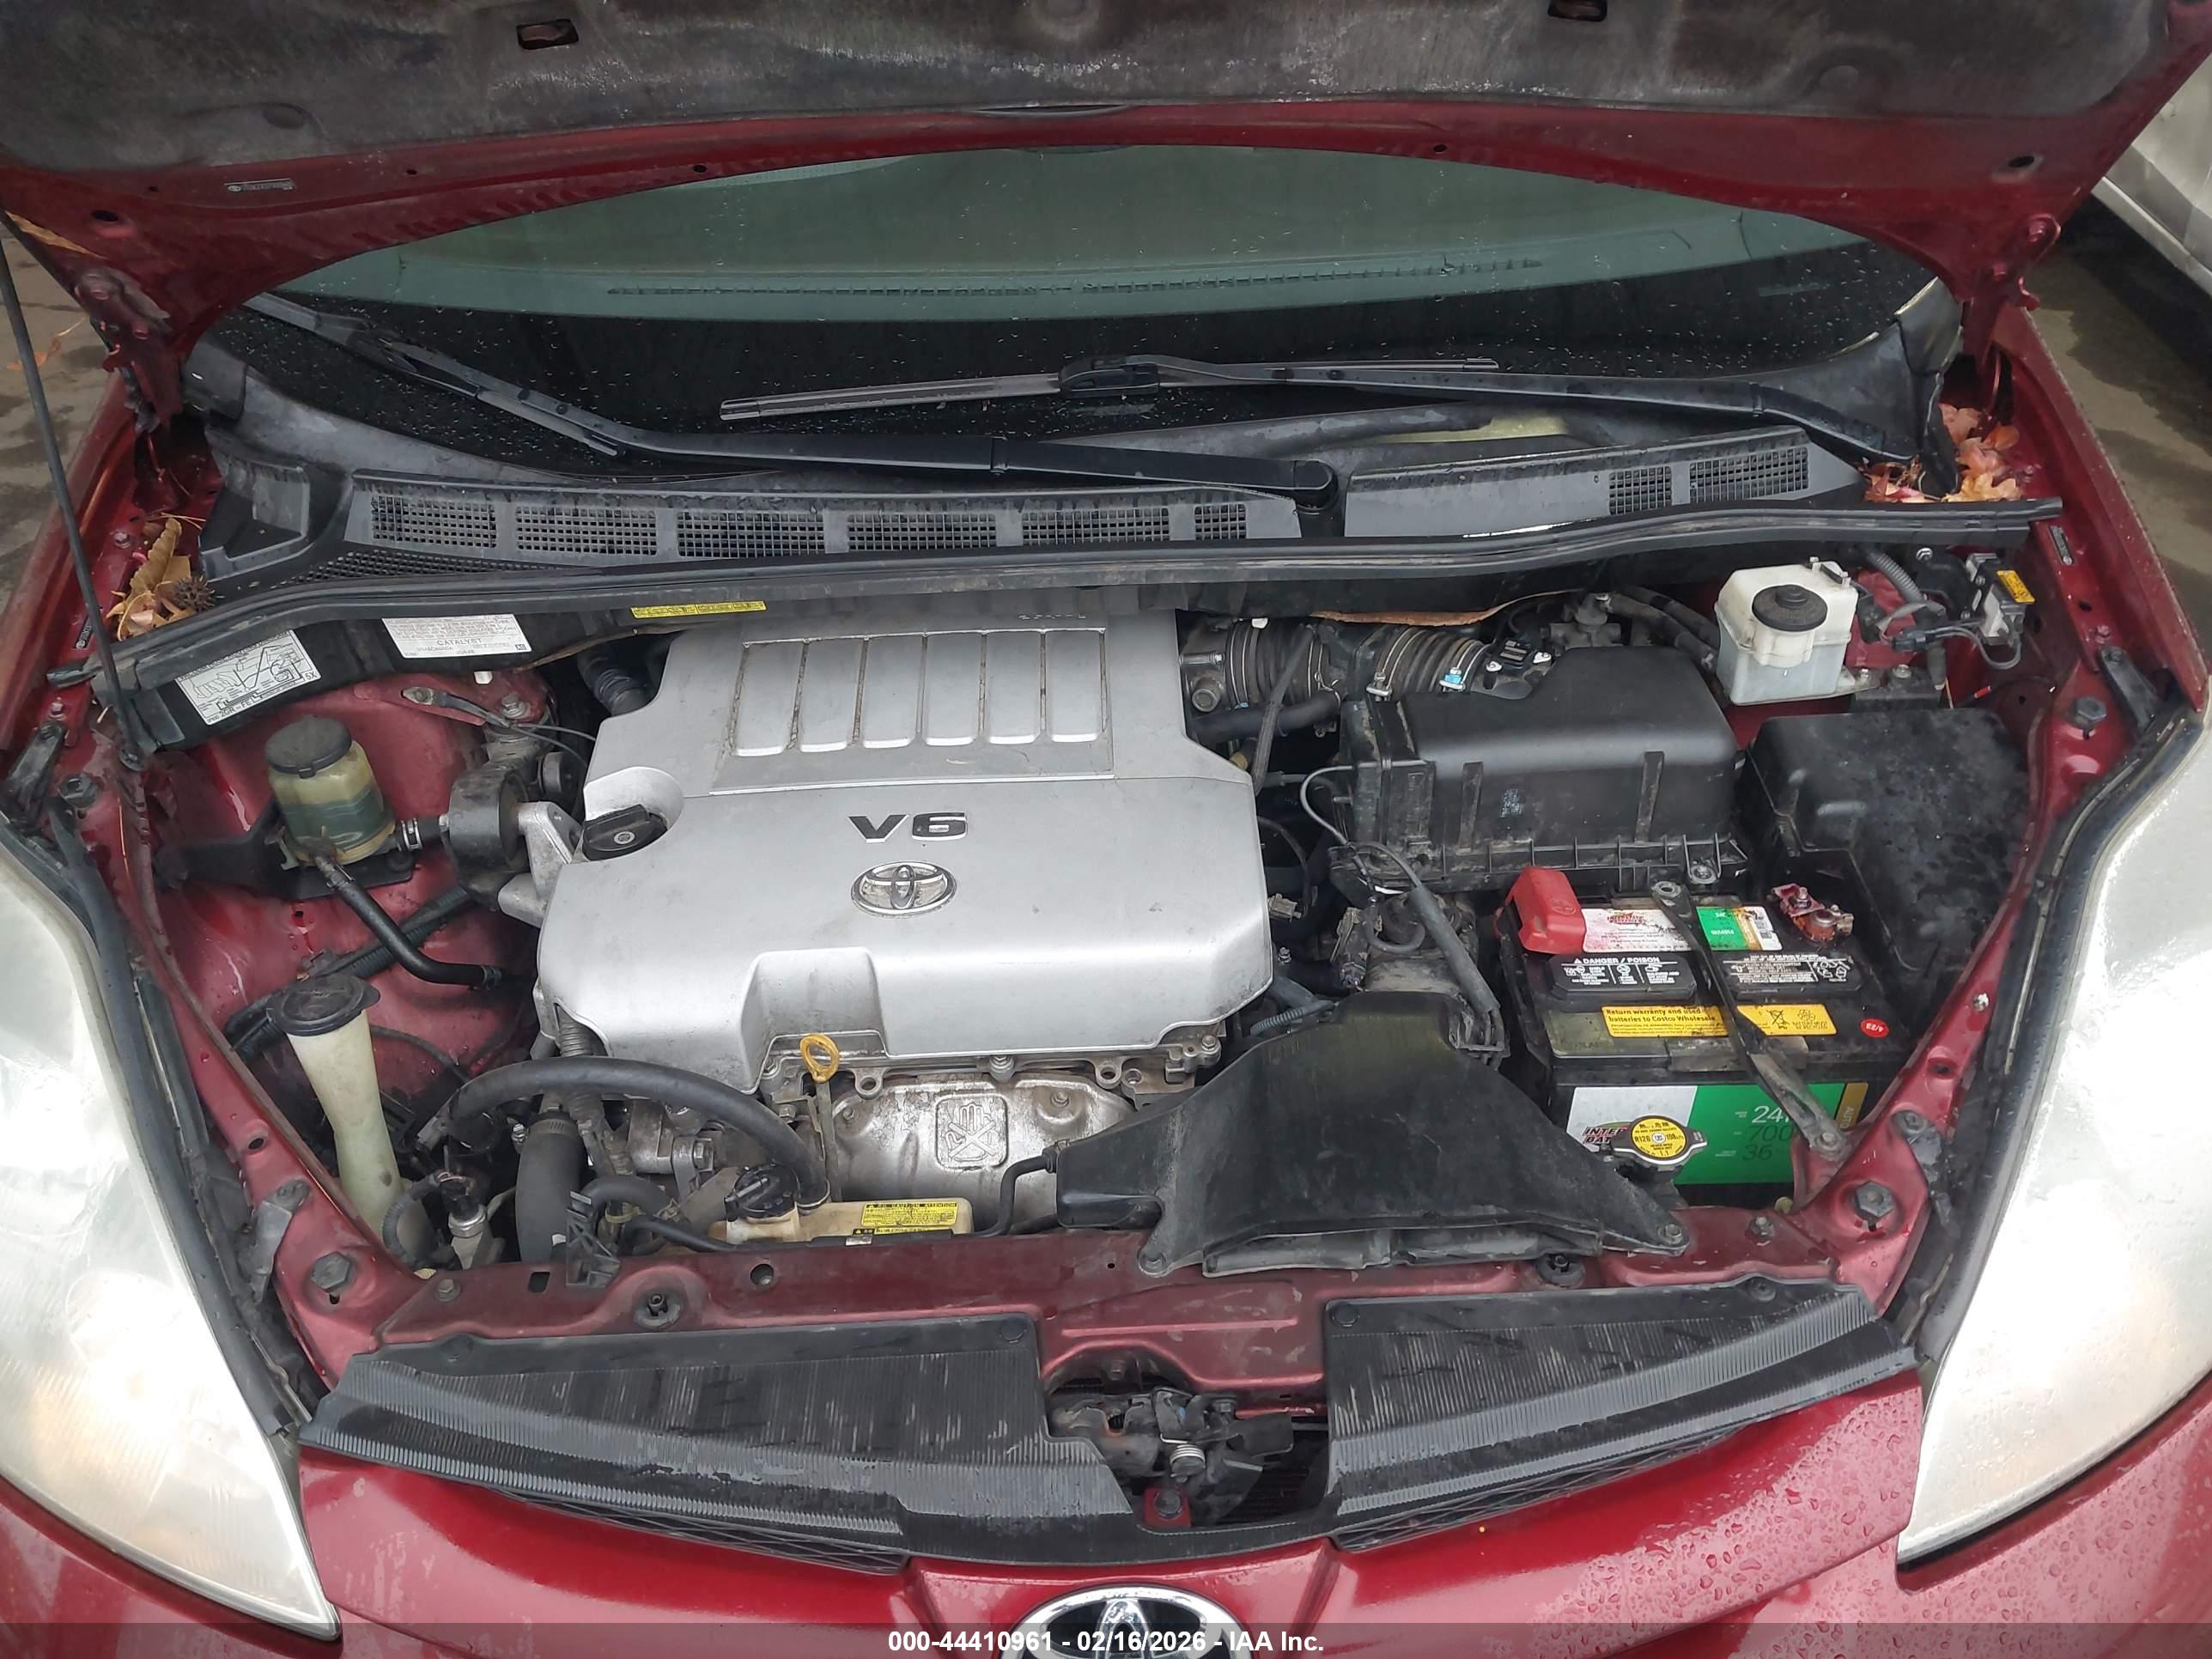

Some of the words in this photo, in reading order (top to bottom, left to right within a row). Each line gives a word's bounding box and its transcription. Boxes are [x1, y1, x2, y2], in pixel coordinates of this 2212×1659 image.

[305, 671, 318, 682] 5X
[848, 811, 968, 844] V6
[1749, 1125, 1793, 1142] 700
[1743, 1144, 1773, 1159] 36
